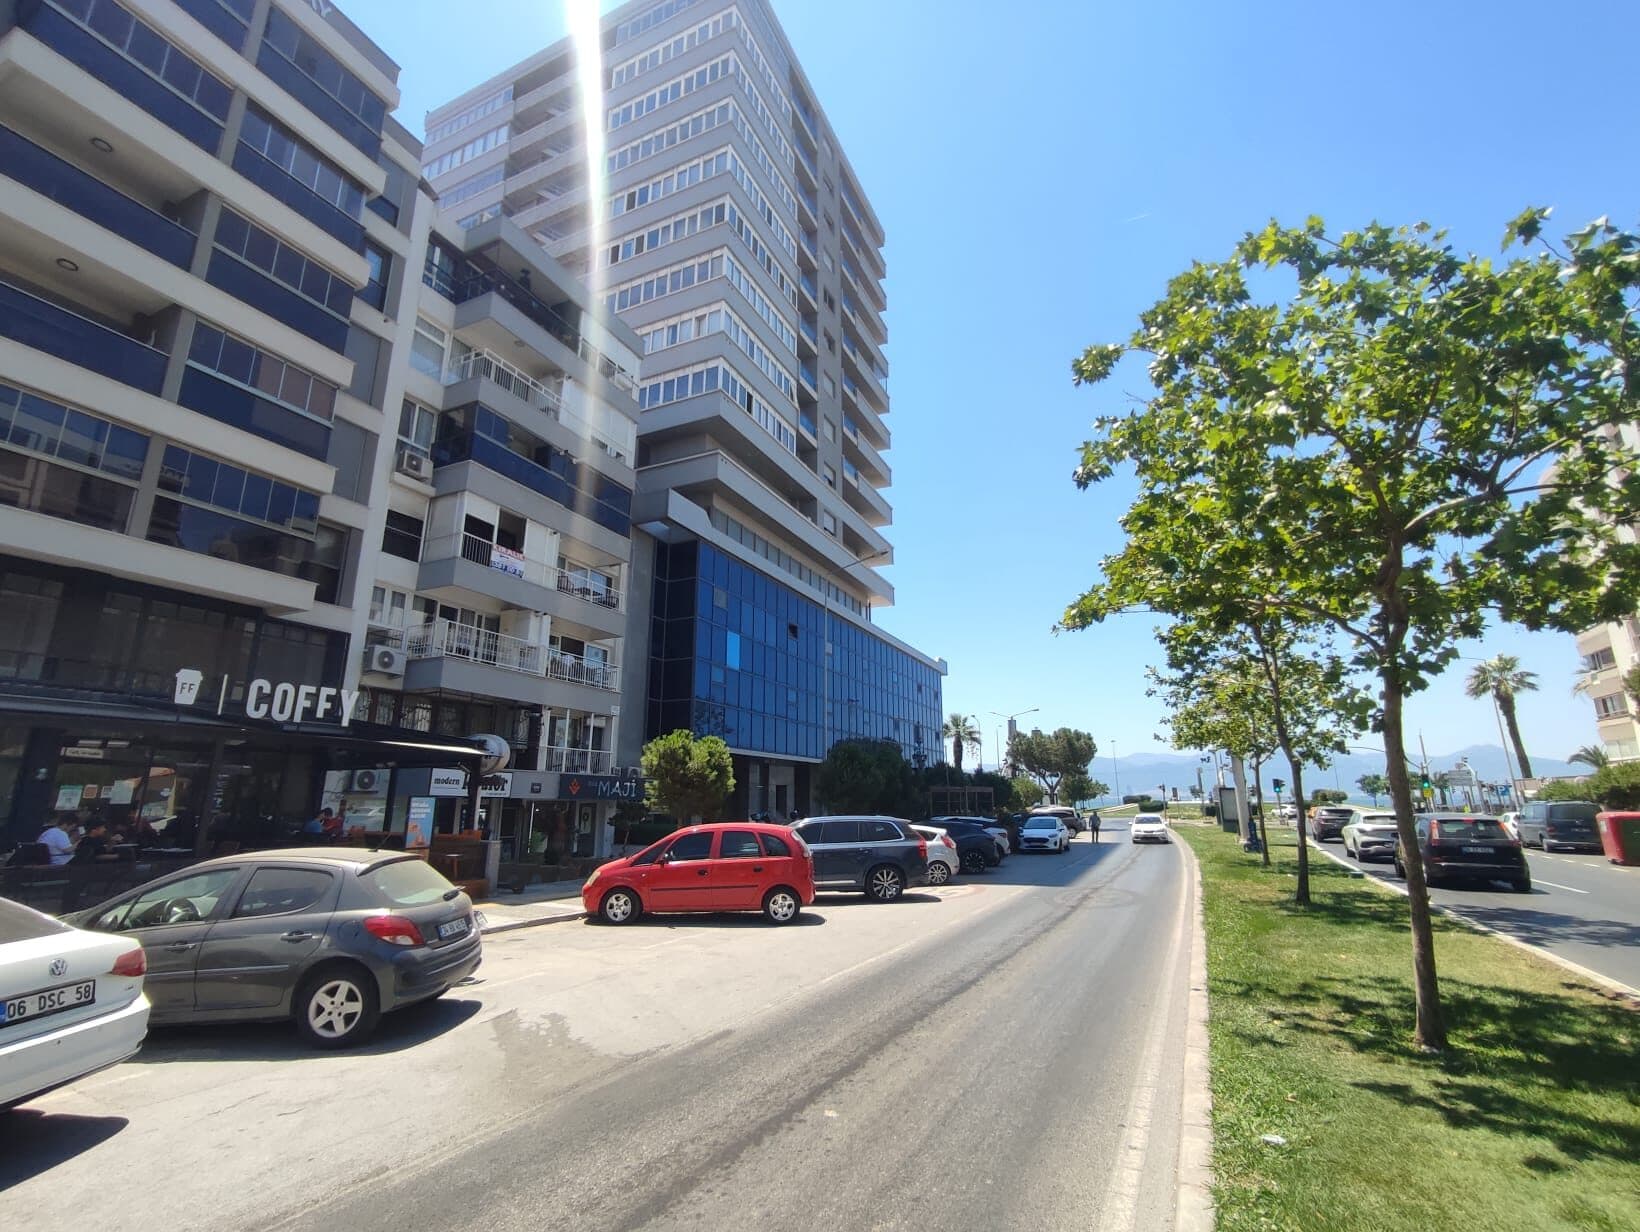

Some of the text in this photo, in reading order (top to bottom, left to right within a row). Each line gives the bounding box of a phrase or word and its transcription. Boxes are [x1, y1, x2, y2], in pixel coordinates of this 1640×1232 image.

[180, 682, 195, 694] FF
[246, 678, 360, 727] COFFY
[434, 776, 460, 785] modern
[7, 984, 91, 1018] 06 DSC 58
